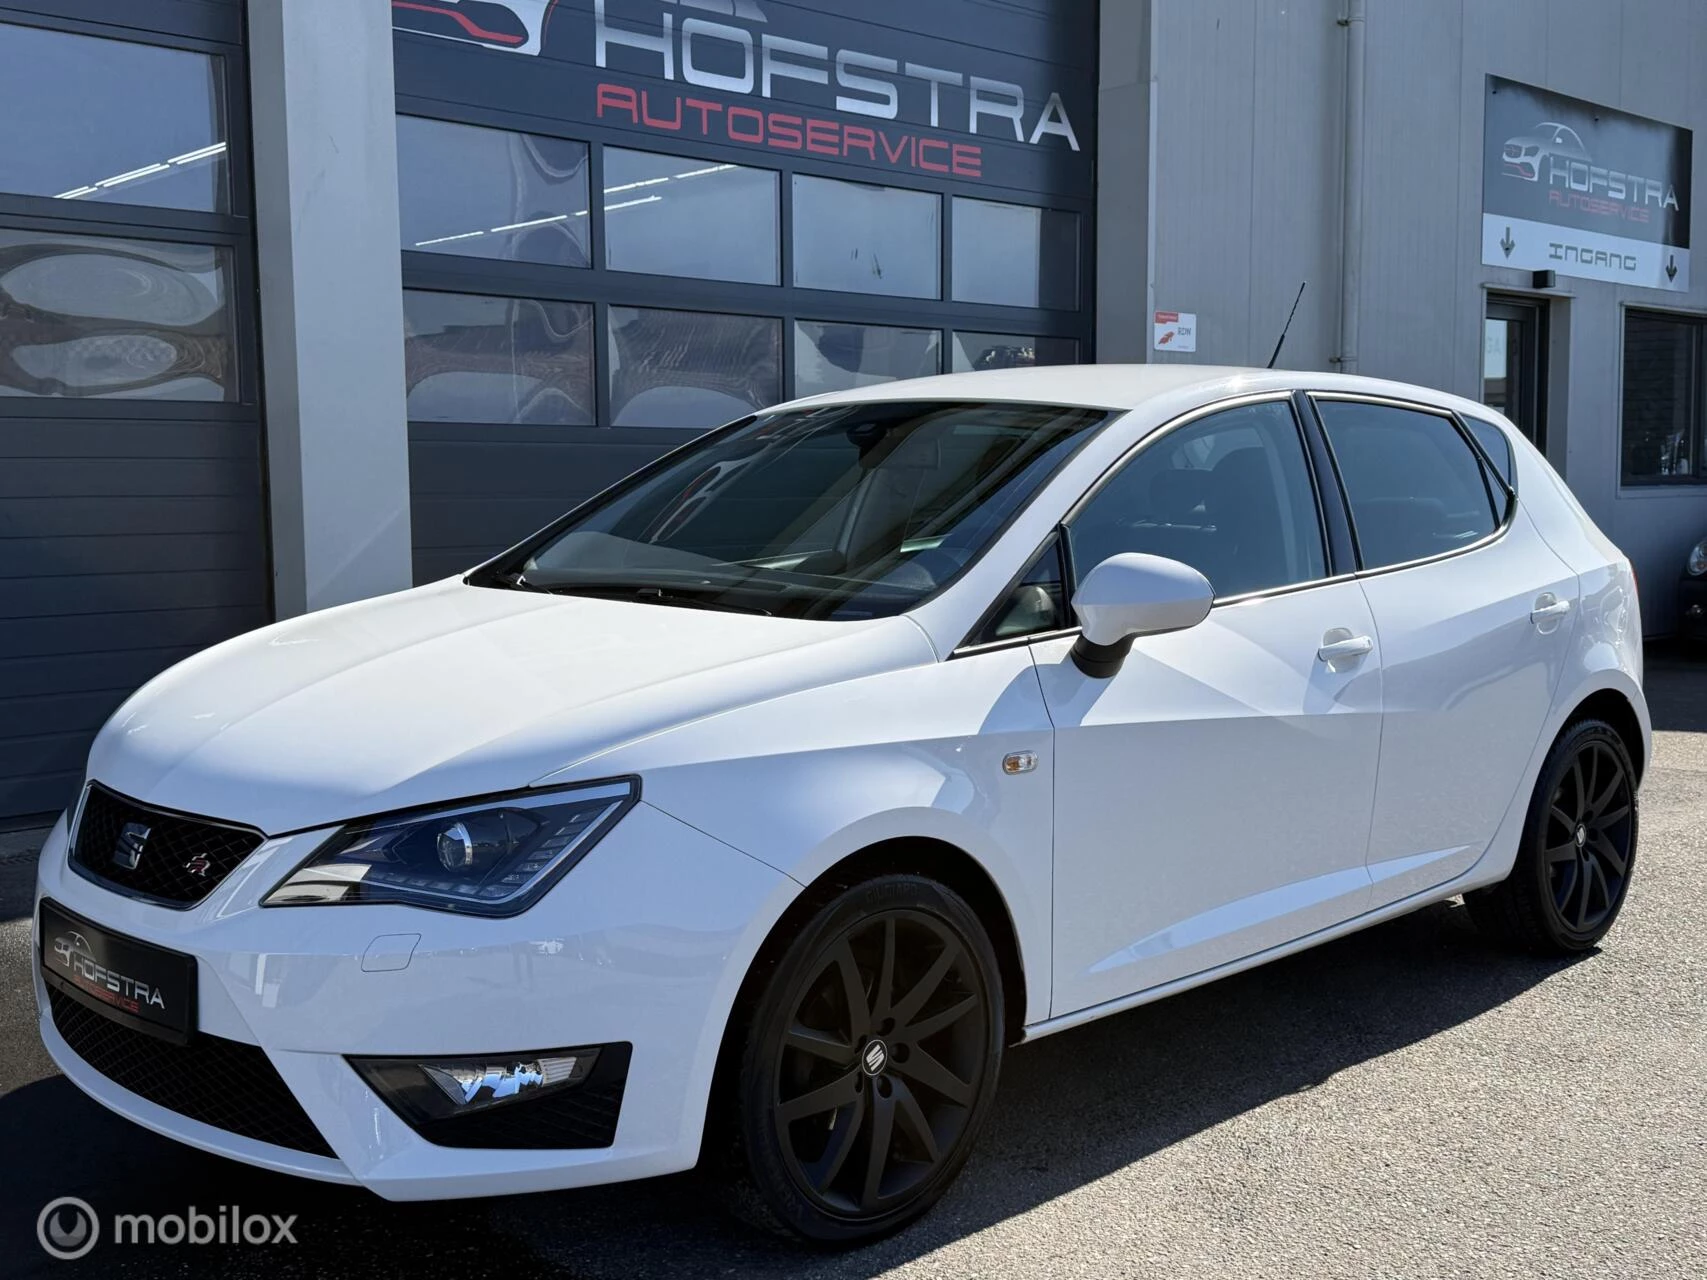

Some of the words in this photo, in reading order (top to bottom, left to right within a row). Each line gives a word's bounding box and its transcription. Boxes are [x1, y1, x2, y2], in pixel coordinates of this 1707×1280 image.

[595, 0, 1081, 152] HOFSTRA
[596, 84, 982, 178] AUTOSERVICE
[1549, 156, 1680, 212] HOFSTRA
[1549, 190, 1650, 223] AUTOSERVICE
[1549, 242, 1637, 271] INGANG
[73, 955, 165, 1009] HOFSTRA
